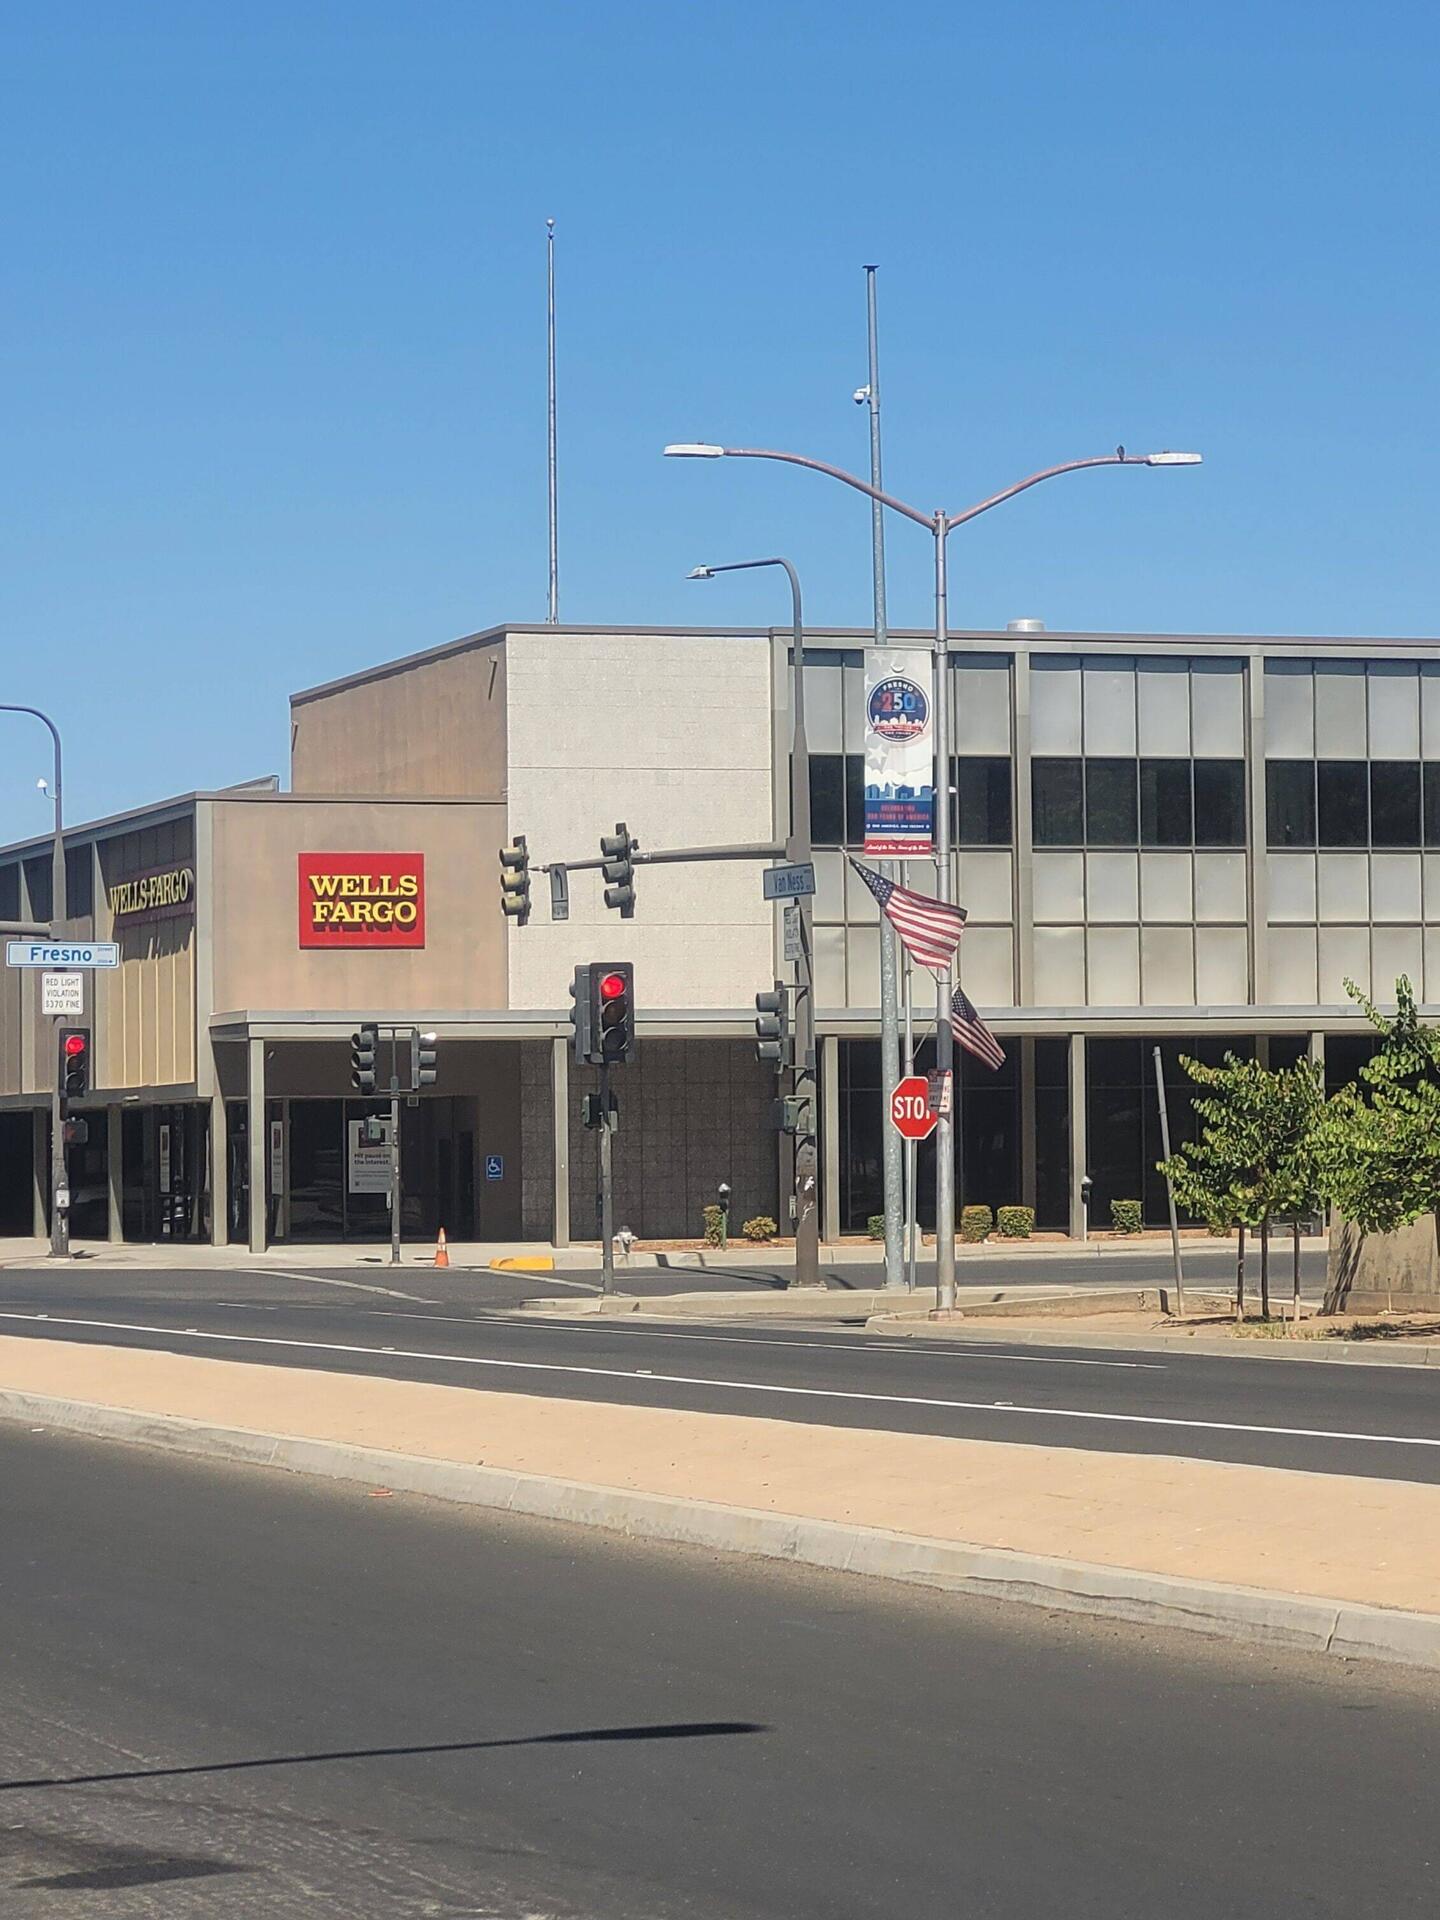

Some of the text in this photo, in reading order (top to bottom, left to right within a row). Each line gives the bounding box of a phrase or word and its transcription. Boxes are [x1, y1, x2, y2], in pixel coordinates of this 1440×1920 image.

[883, 682, 914, 692] FRESNO
[882, 692, 916, 710] 250
[308, 875, 418, 896] WELLS
[773, 871, 805, 892] Van Ness
[312, 901, 417, 923] FARGO
[30, 947, 92, 961] Fresno
[46, 978, 79, 986] RED LIGHT
[46, 989, 79, 997] VIOLATION
[66, 1000, 80, 1008] FINE
